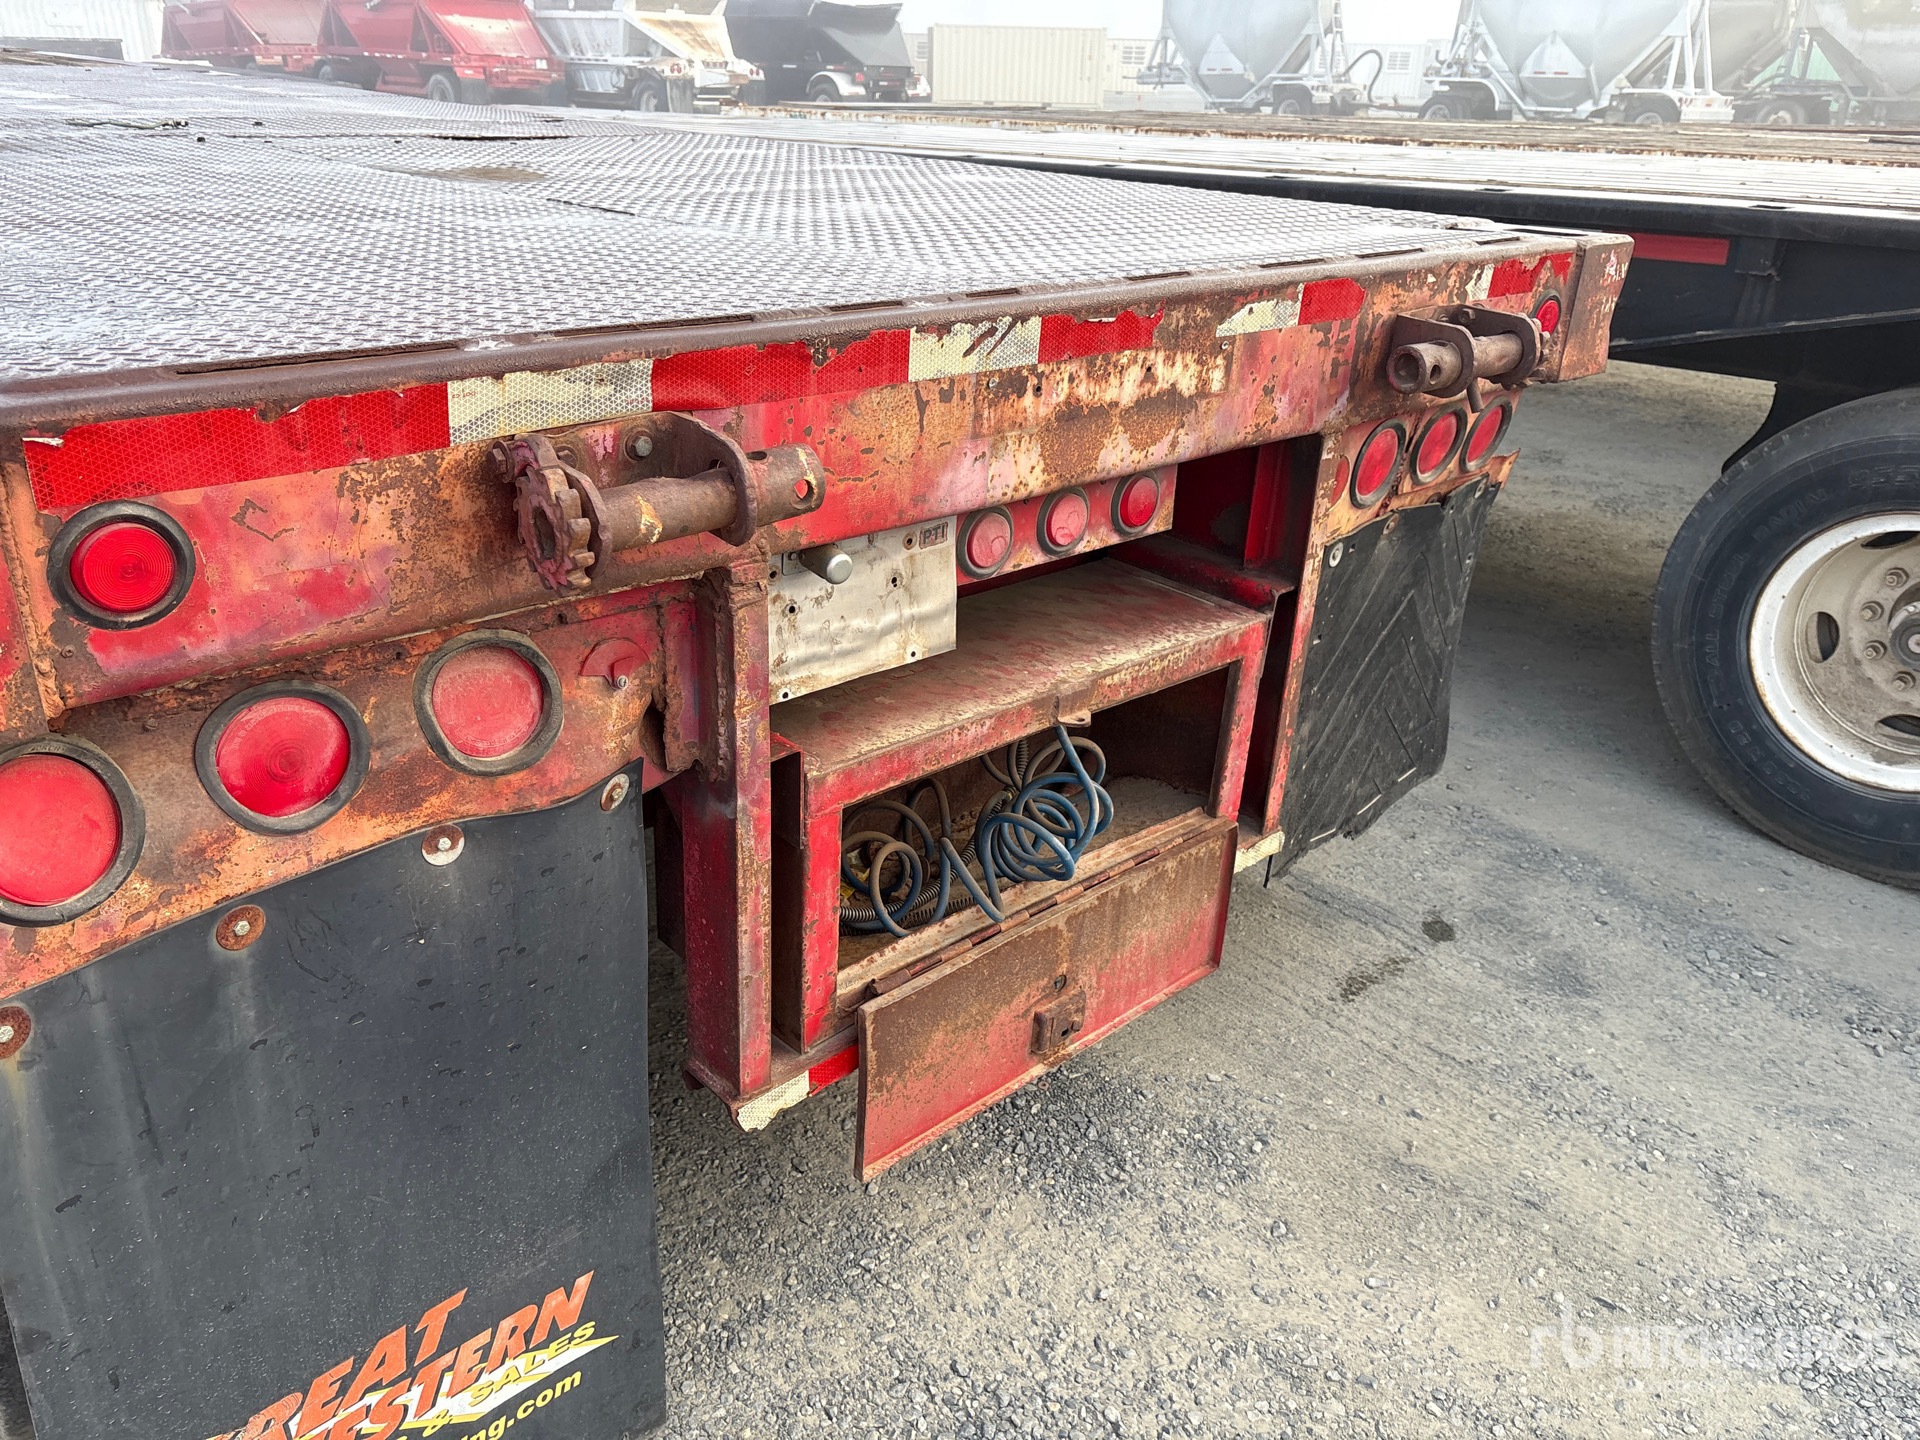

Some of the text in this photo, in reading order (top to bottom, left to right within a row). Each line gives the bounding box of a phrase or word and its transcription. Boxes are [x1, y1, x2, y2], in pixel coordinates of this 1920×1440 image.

[923, 523, 946, 545] PTI
[1705, 630, 1721, 667] ALL
[212, 1287, 468, 1440] REAT
[310, 1269, 595, 1440] ESTERN
[468, 1321, 597, 1408] SALES
